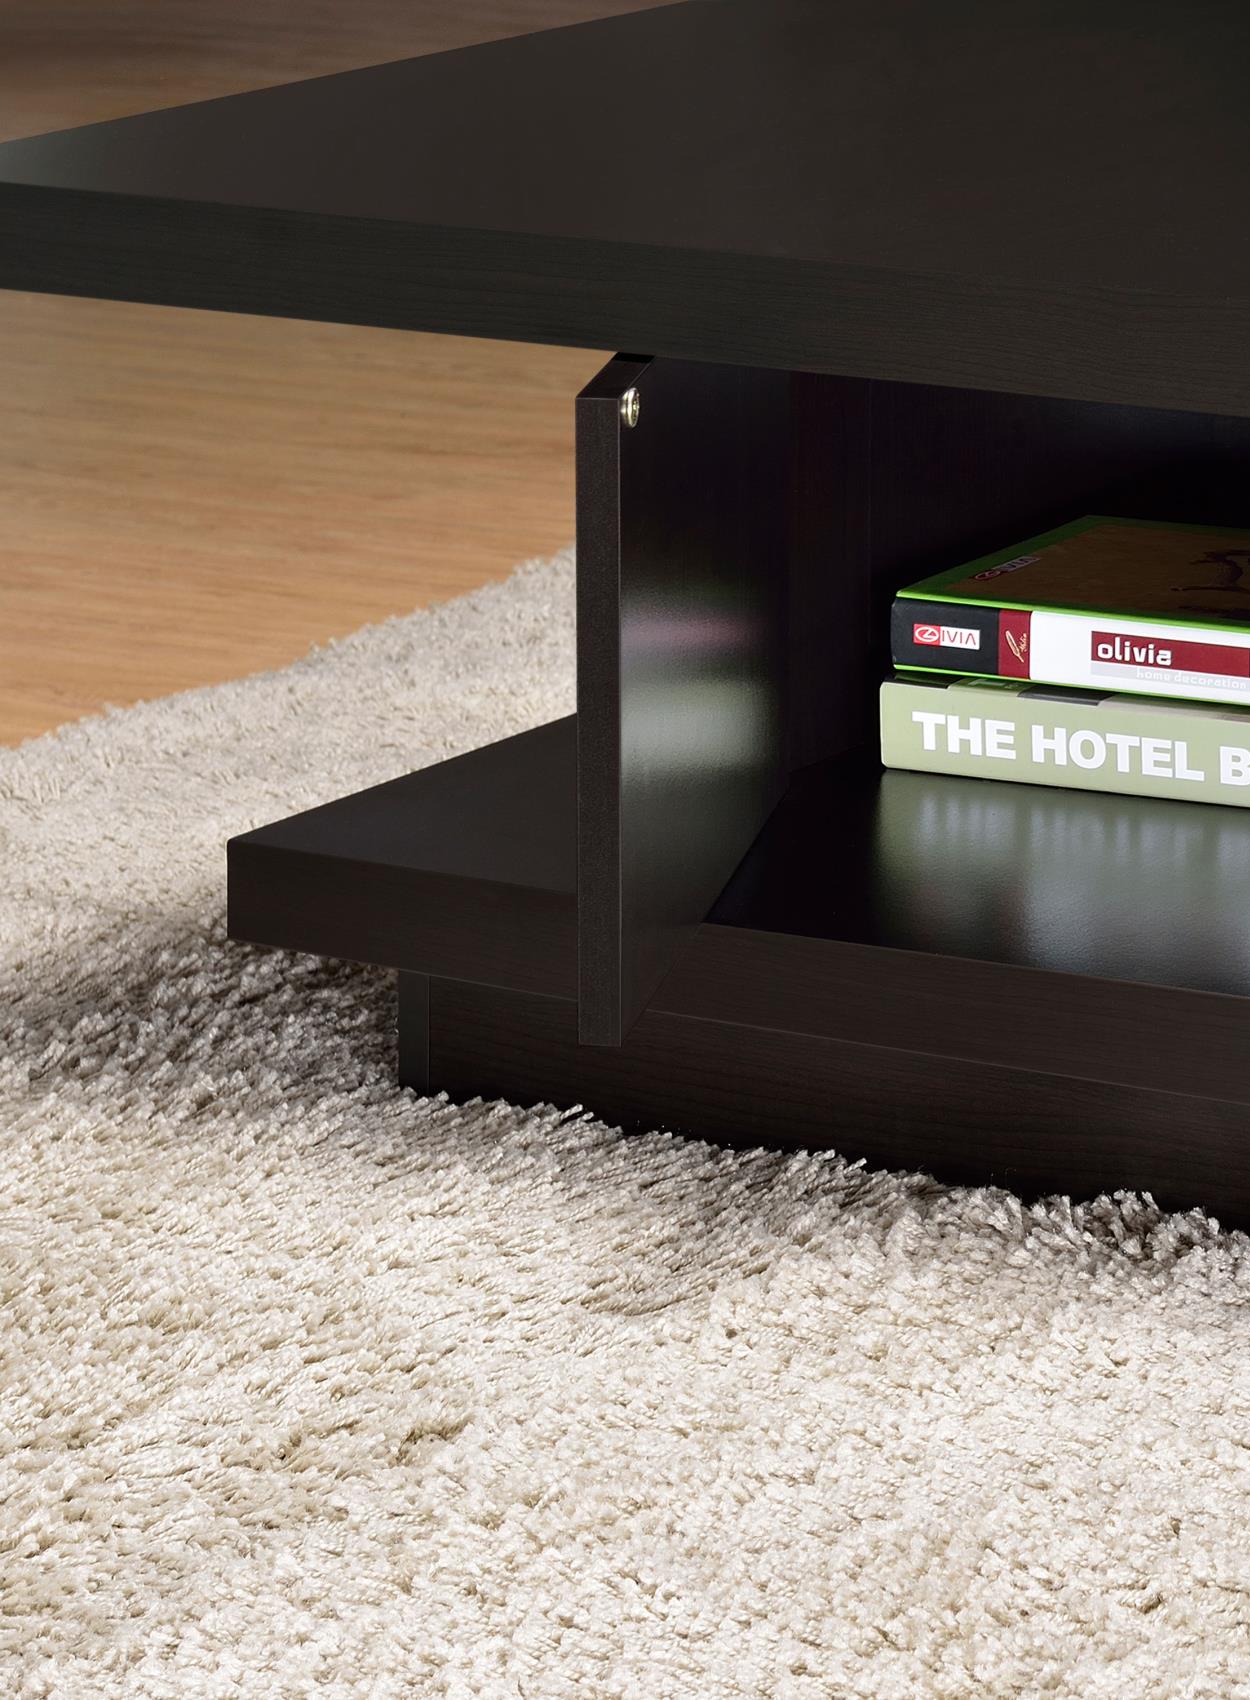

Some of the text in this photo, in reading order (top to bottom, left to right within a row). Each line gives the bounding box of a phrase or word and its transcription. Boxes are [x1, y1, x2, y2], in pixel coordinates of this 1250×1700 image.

[1097, 636, 1171, 665] olivia
[1136, 667, 1248, 690] home decoration
[911, 712, 1016, 760] THE
[1031, 723, 1205, 781] HOTEL
